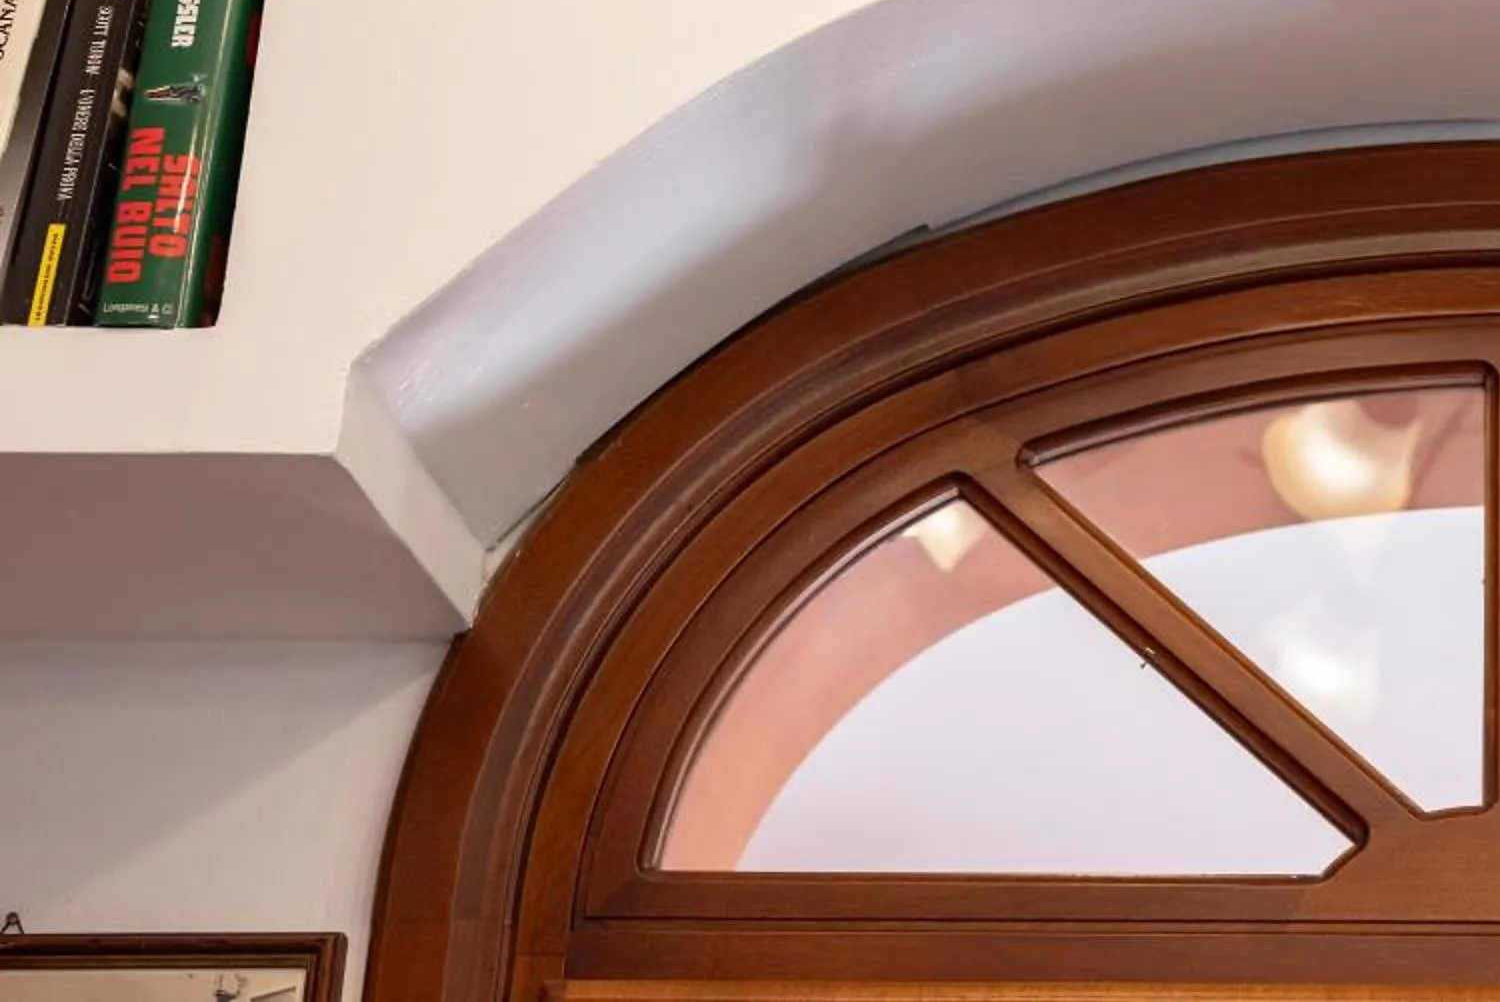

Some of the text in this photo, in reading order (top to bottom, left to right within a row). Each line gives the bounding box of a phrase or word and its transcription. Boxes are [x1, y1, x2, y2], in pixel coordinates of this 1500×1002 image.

[94, 5, 113, 37] SCOTT
[84, 39, 110, 75] TUROW
[64, 133, 87, 165] DELLA
[56, 167, 81, 202] PROVA
[107, 126, 165, 283] NEL BUIO
[150, 153, 201, 258] SALTO
